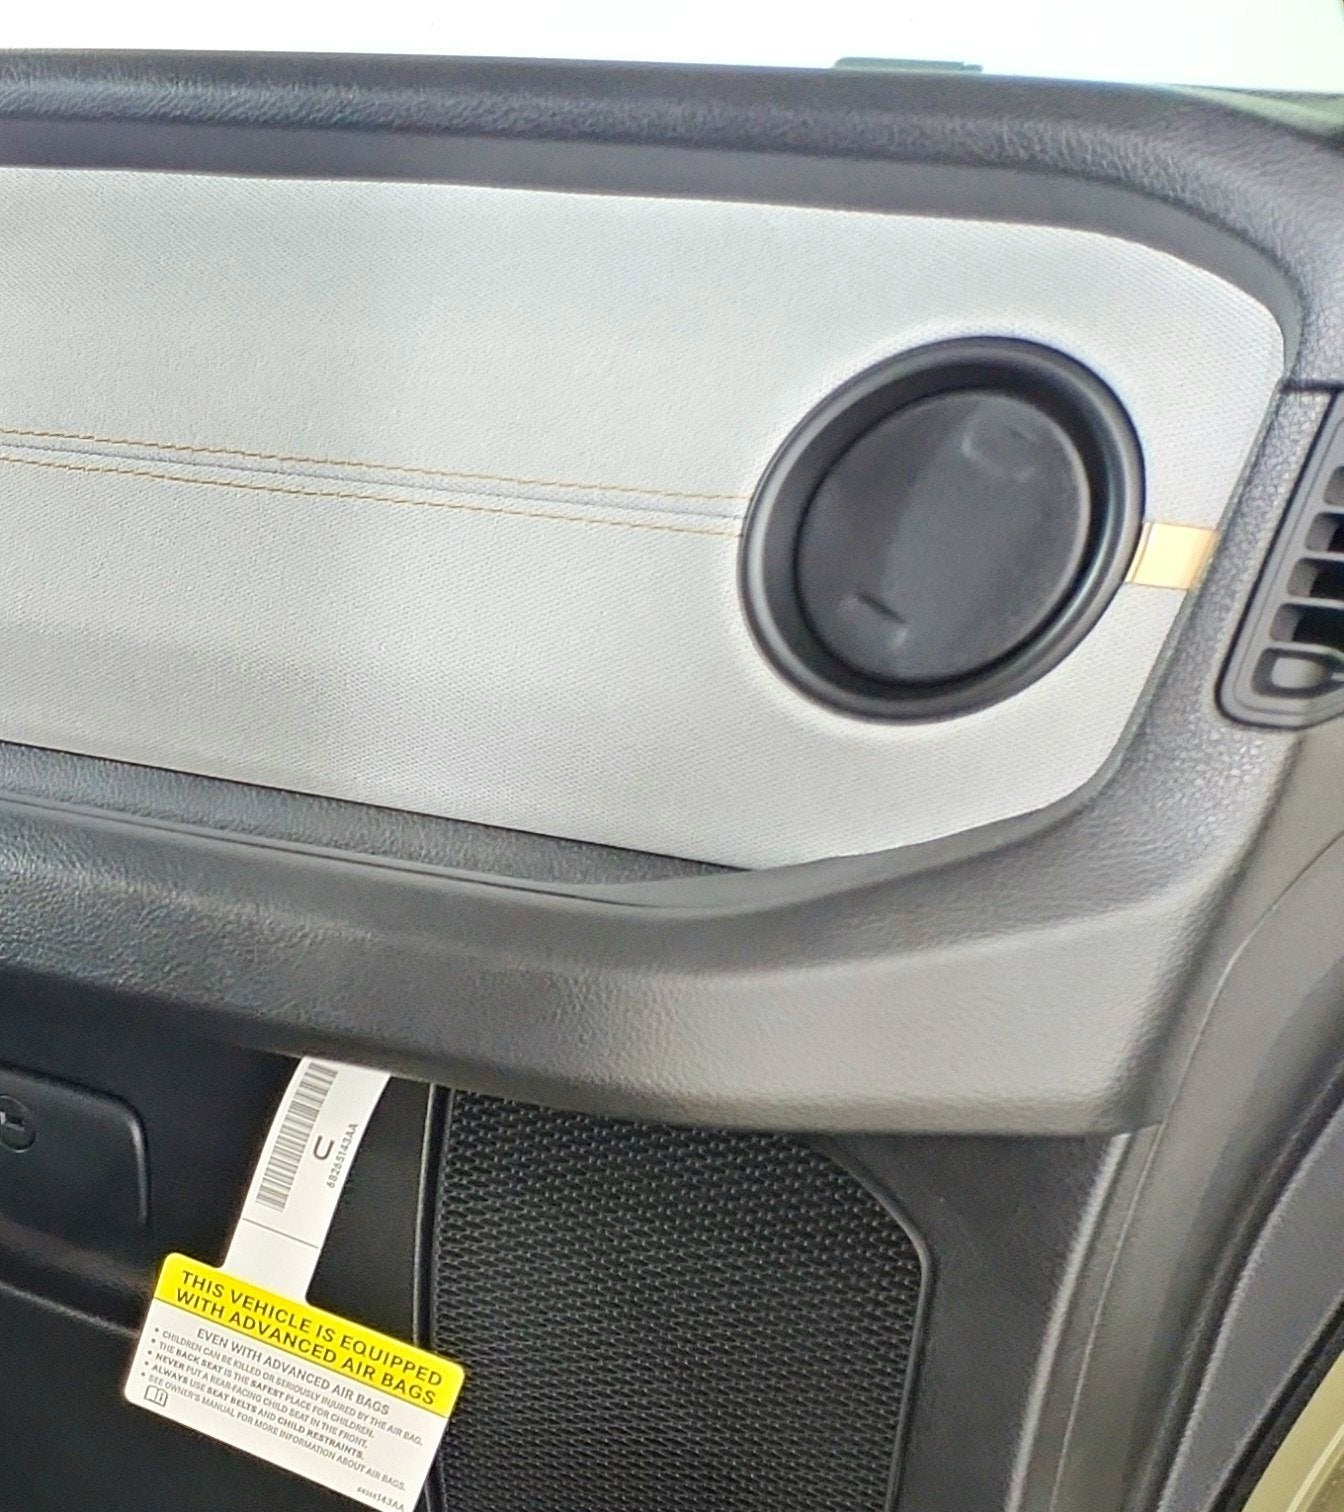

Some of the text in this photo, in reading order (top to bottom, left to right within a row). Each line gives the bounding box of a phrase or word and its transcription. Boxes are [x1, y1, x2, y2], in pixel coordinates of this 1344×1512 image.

[326, 1123, 358, 1189] 68265143AA
[173, 1287, 437, 1405] WITH ADVANCED AIR BAGS
[179, 1269, 444, 1387] THIS VEHICLE IS EQUIPPED
[196, 1327, 390, 1416] EVEN WITH ADVANCED AIR BAGS
[148, 1373, 408, 1491] SEE OWNER'S MANUAL FOR MORE INFORMATION ABOUT AIR BAGS.
[151, 1363, 366, 1460] ALWAYS USE SEAT BELTS AND CHILD RESTRAINTS.
[154, 1352, 369, 1449] NEVER PUT A REAR-FACING CHILD SEAT IN THE FRONT.
[157, 1340, 376, 1438] THE BACK SEAT IS THE SAFEST PLACE FOR CHILDREN.
[161, 1330, 425, 1446] CHILDREN CAN BE KILLED OR SERIOUSLY INJURED BY THE AIR BAG.
